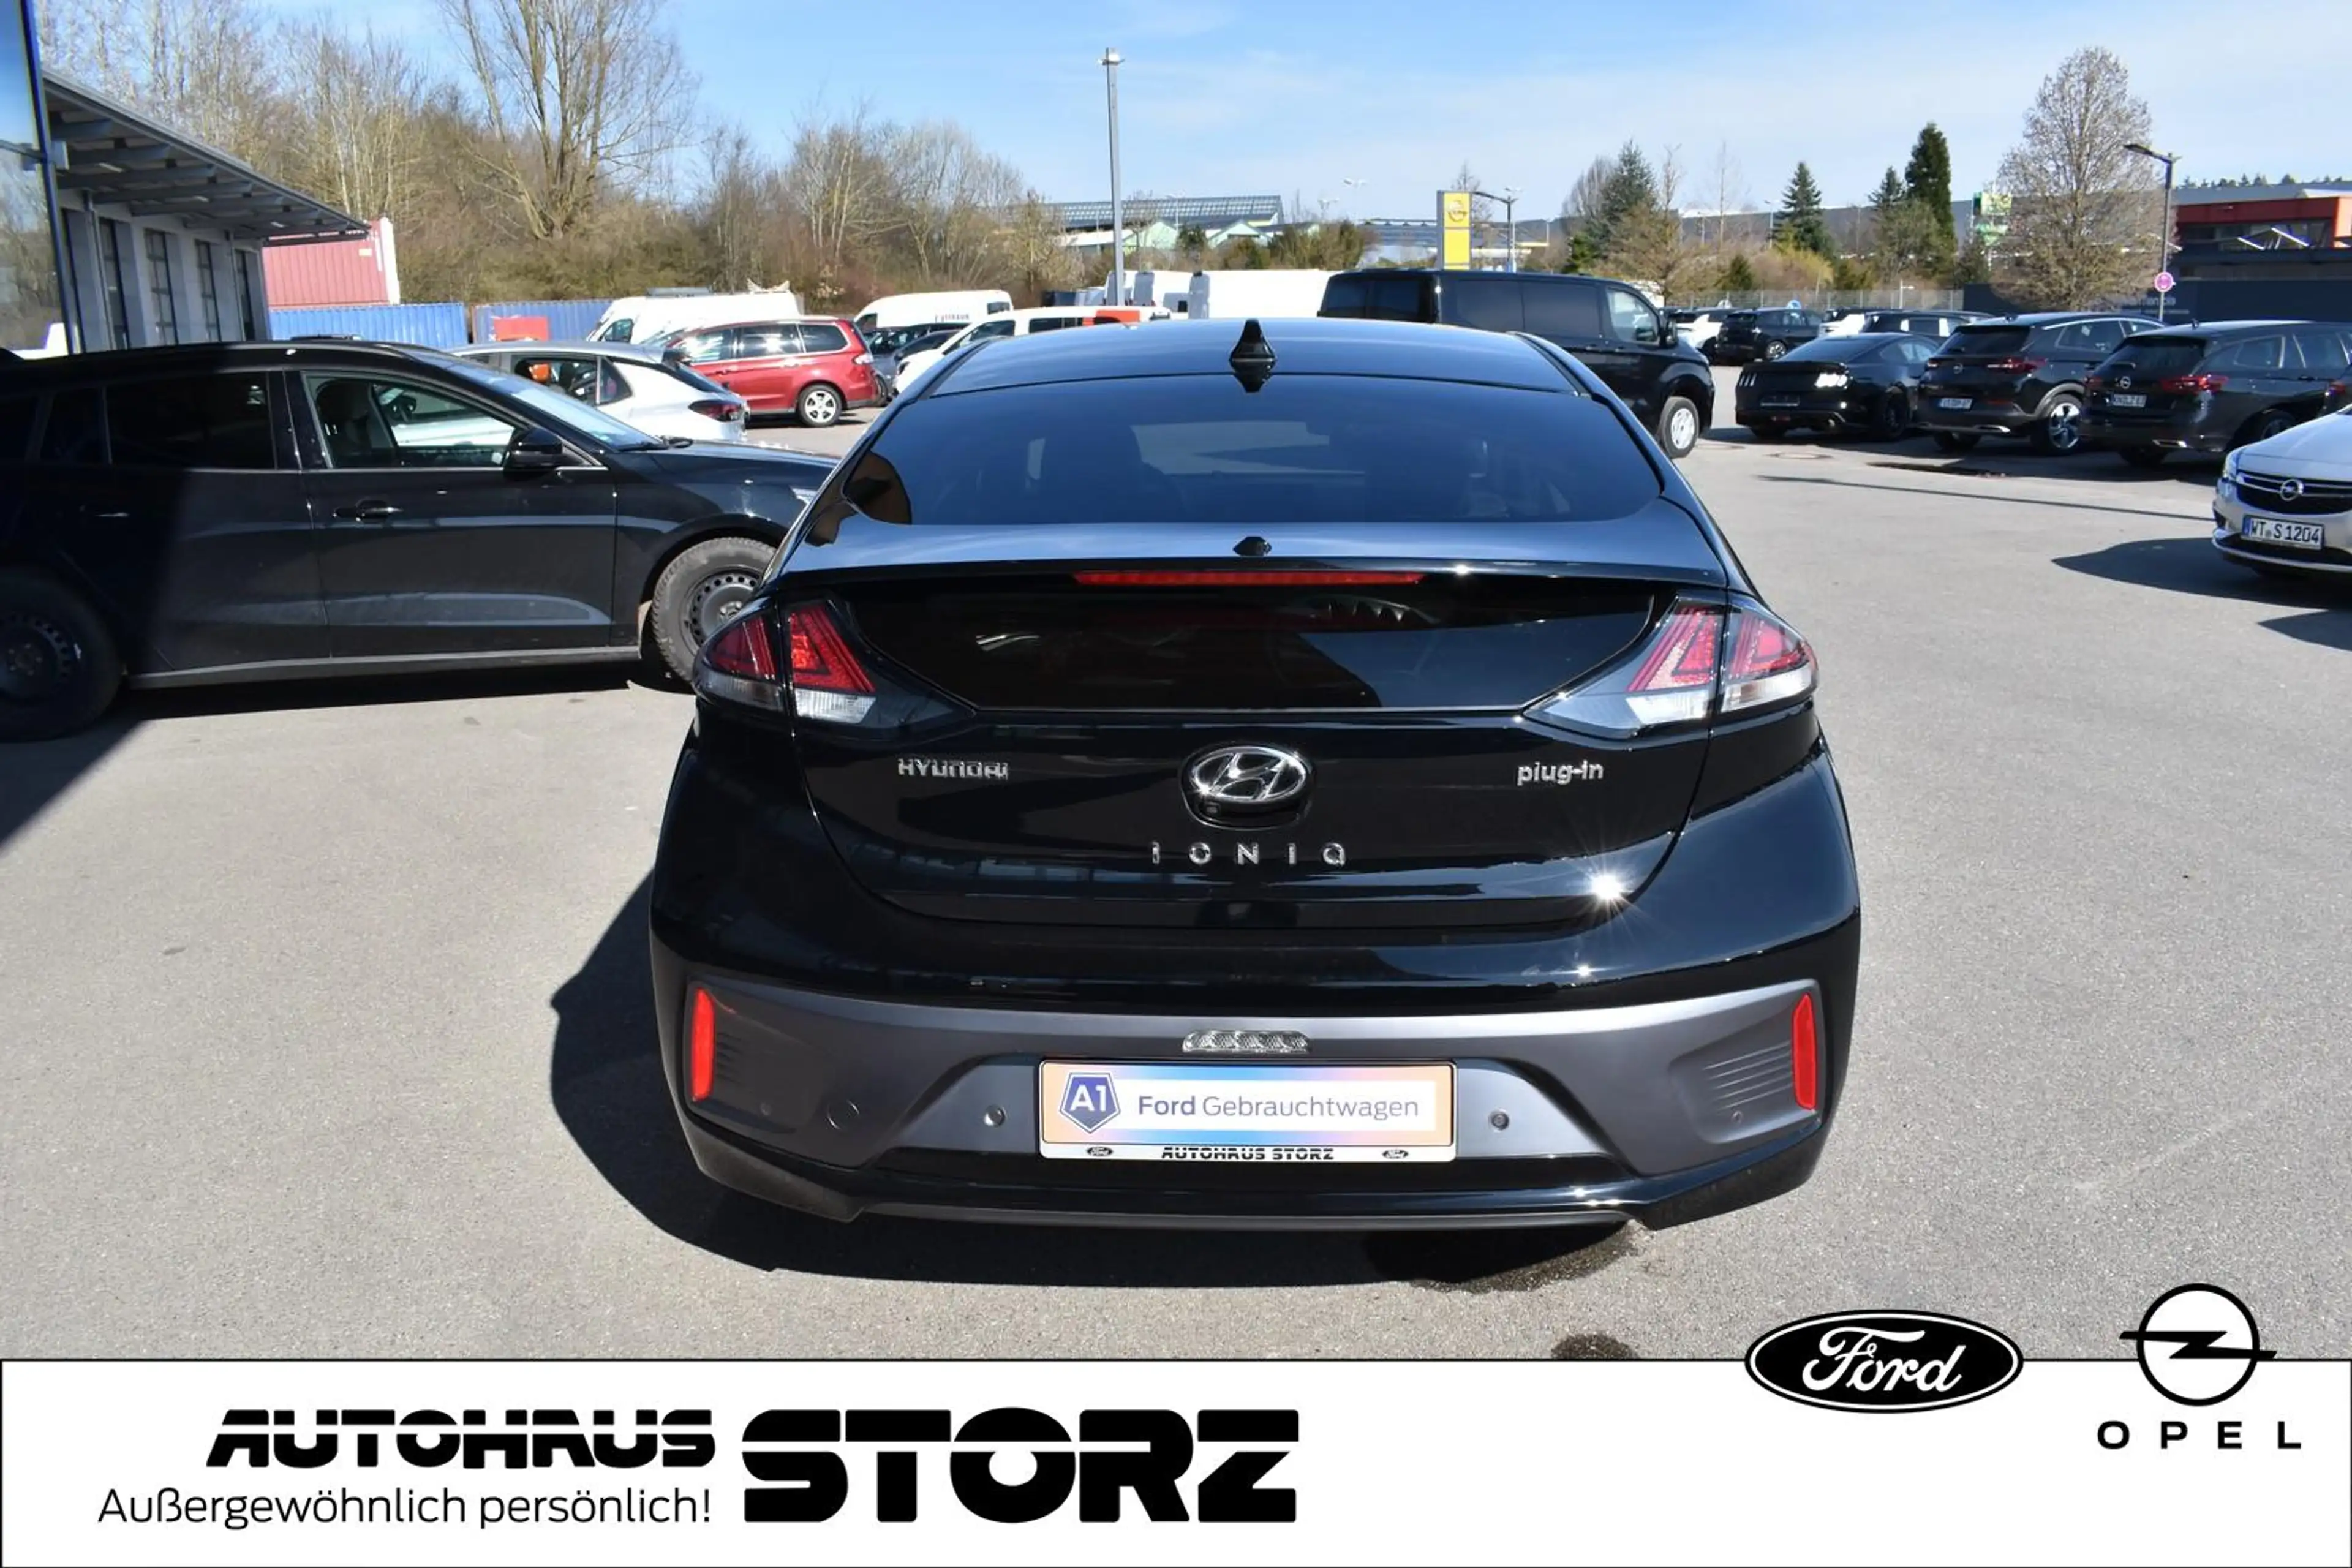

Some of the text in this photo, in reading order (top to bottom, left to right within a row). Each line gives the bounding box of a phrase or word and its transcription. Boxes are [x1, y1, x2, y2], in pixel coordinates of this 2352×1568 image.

[2274, 523, 2283, 538] S
[2285, 525, 2320, 543] 1204
[1517, 760, 1604, 786] plug-in
[1152, 841, 1346, 865] IONIQ
[1070, 1084, 1107, 1112] A1
[1139, 1095, 1418, 1120] Ford Gebrauchtwagen
[1161, 1147, 1334, 1161] AUTOHAUS STORZ
